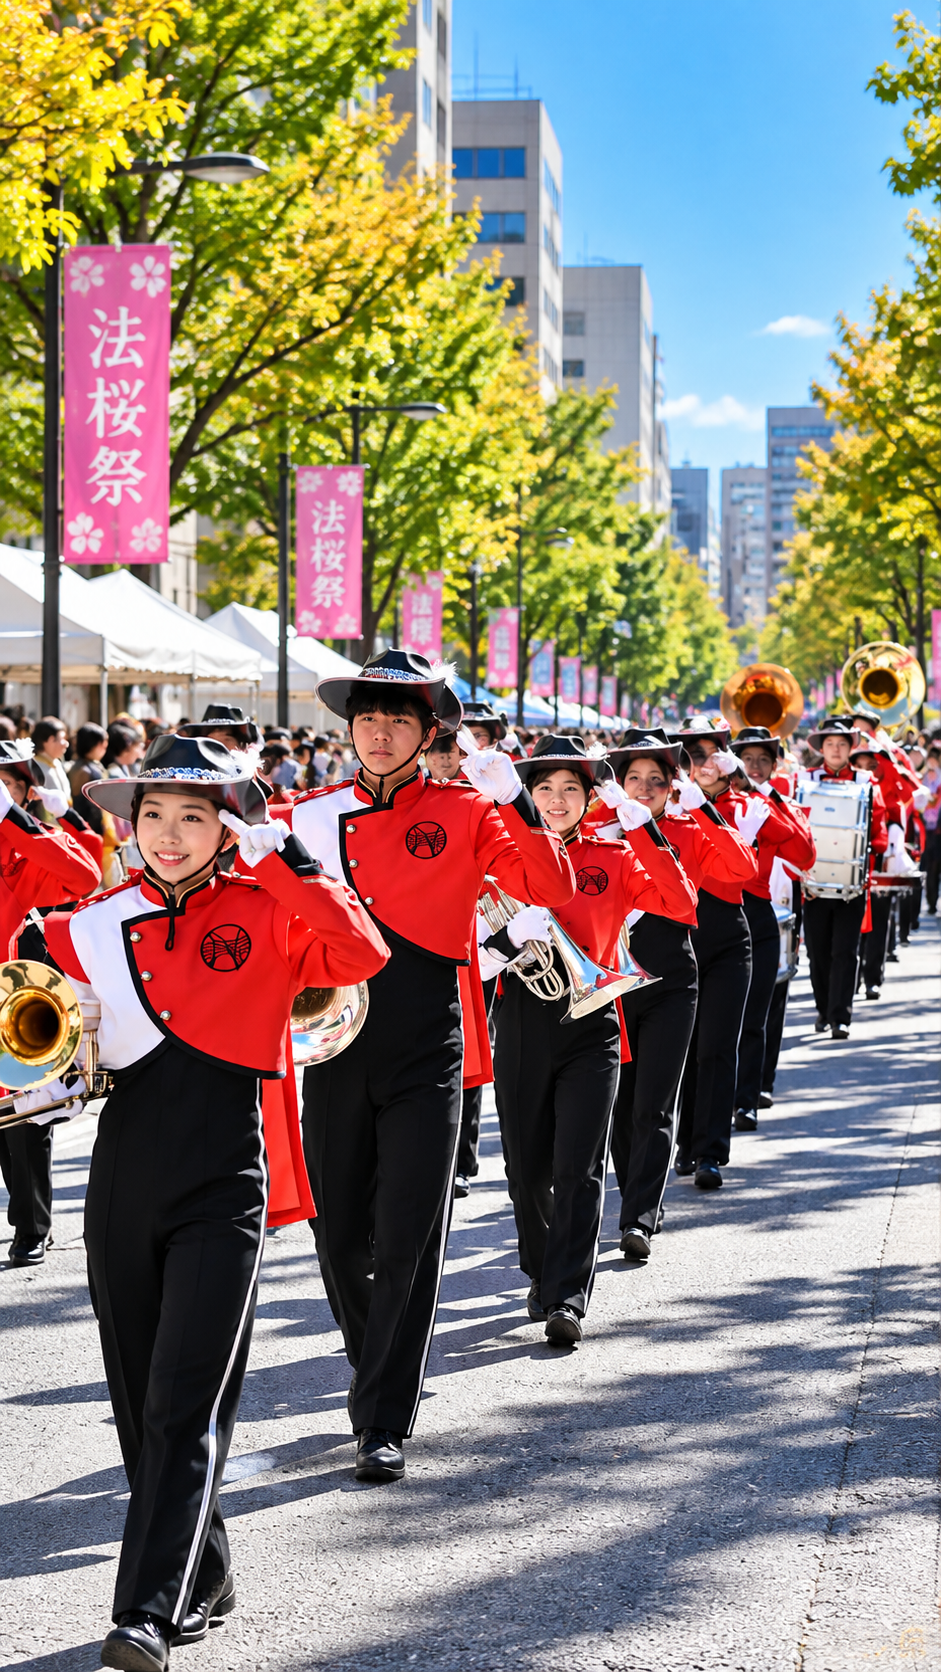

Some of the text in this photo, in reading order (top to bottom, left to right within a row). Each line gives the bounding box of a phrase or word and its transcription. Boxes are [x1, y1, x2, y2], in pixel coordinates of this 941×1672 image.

[86, 306, 147, 507] 法桜祭
[310, 498, 347, 609] 法桜祭
